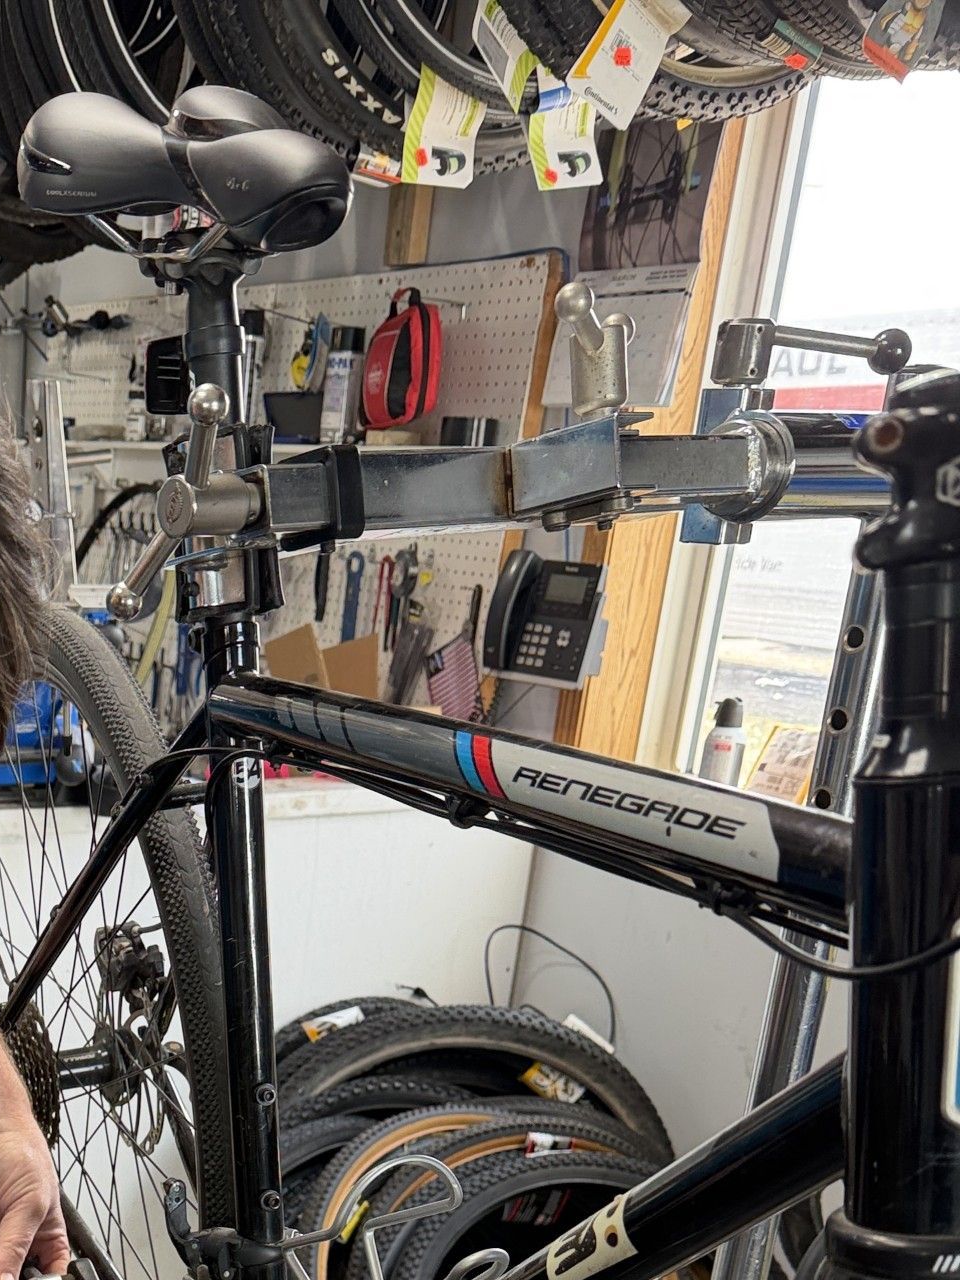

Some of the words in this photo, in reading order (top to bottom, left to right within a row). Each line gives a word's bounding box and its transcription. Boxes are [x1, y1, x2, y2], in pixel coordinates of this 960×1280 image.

[322, 48, 403, 124] AXXIS
[584, 86, 615, 112] Continental
[235, 758, 261, 784] 54
[512, 766, 747, 840] RENEGADE
